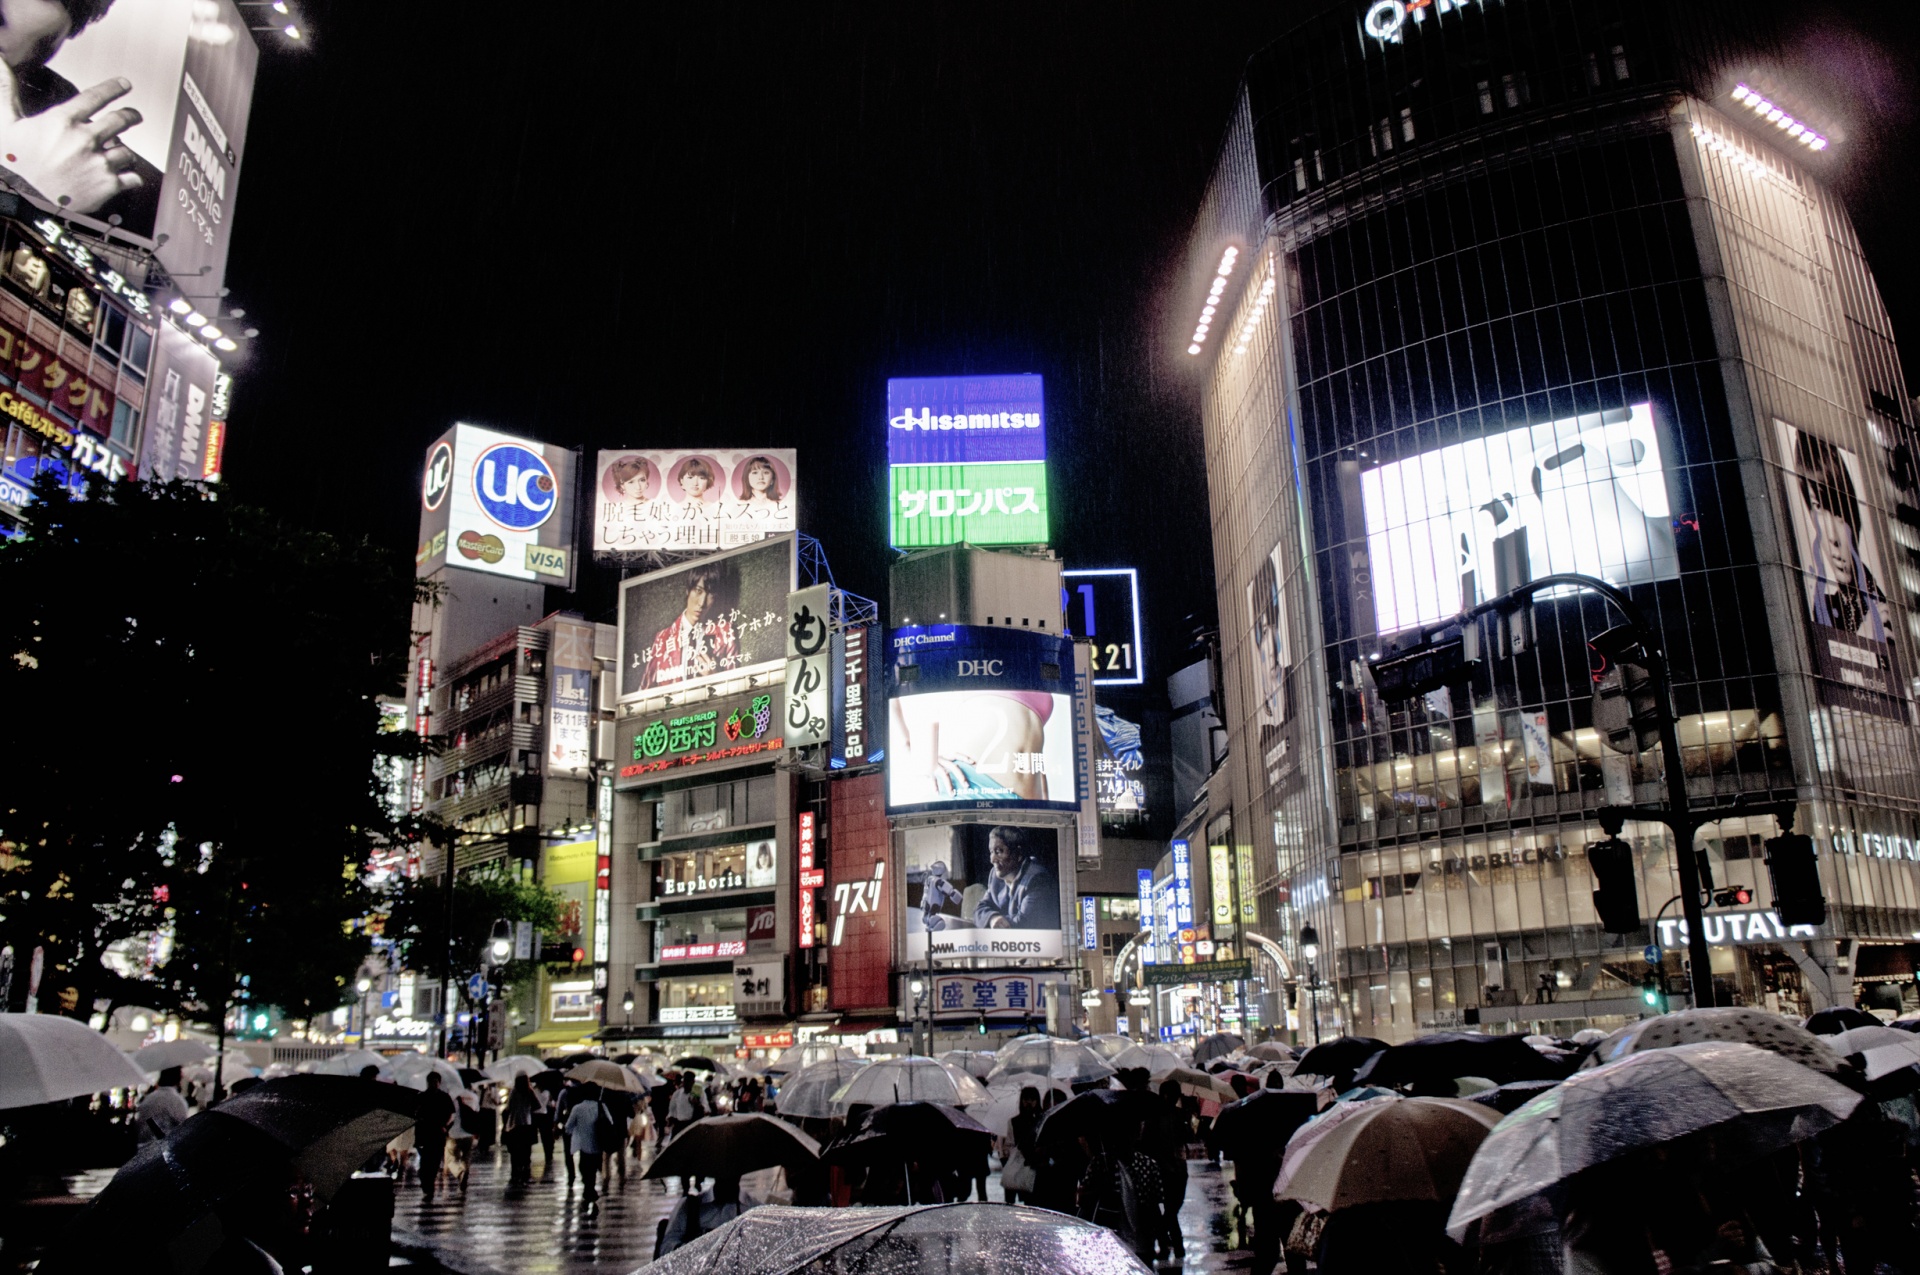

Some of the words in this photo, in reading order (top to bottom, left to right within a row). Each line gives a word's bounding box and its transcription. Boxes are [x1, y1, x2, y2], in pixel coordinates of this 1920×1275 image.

[184, 113, 226, 201] DMM
[179, 152, 223, 225] mobile
[178, 187, 215, 246] のスマホ
[180, 383, 206, 465] DMM
[890, 407, 1041, 430] Hisamitsu
[72, 433, 127, 482] ガスト
[898, 487, 1040, 518] サロンパス
[603, 524, 719, 545] しちゃう理由
[458, 539, 504, 556] MasterCard
[530, 552, 564, 570] VISA
[894, 636, 914, 648] DHC
[916, 632, 955, 645] Channel
[719, 652, 752, 669] のスマホ
[957, 660, 1003, 676] DHC
[1105, 643, 1132, 670] 21
[789, 605, 826, 738] もんじゃ
[844, 632, 863, 758] 三千里薬品
[553, 711, 588, 728] 夜11時
[560, 728, 581, 740] まで
[670, 721, 717, 752] 西村
[1013, 752, 1046, 775] 週間
[1078, 743, 1089, 800] neon
[665, 873, 742, 895] Euphoria
[1174, 844, 1191, 922] 洋服の青山
[832, 861, 885, 946] クスリ
[750, 911, 774, 934] JTB
[991, 941, 1041, 953] ROBOTS
